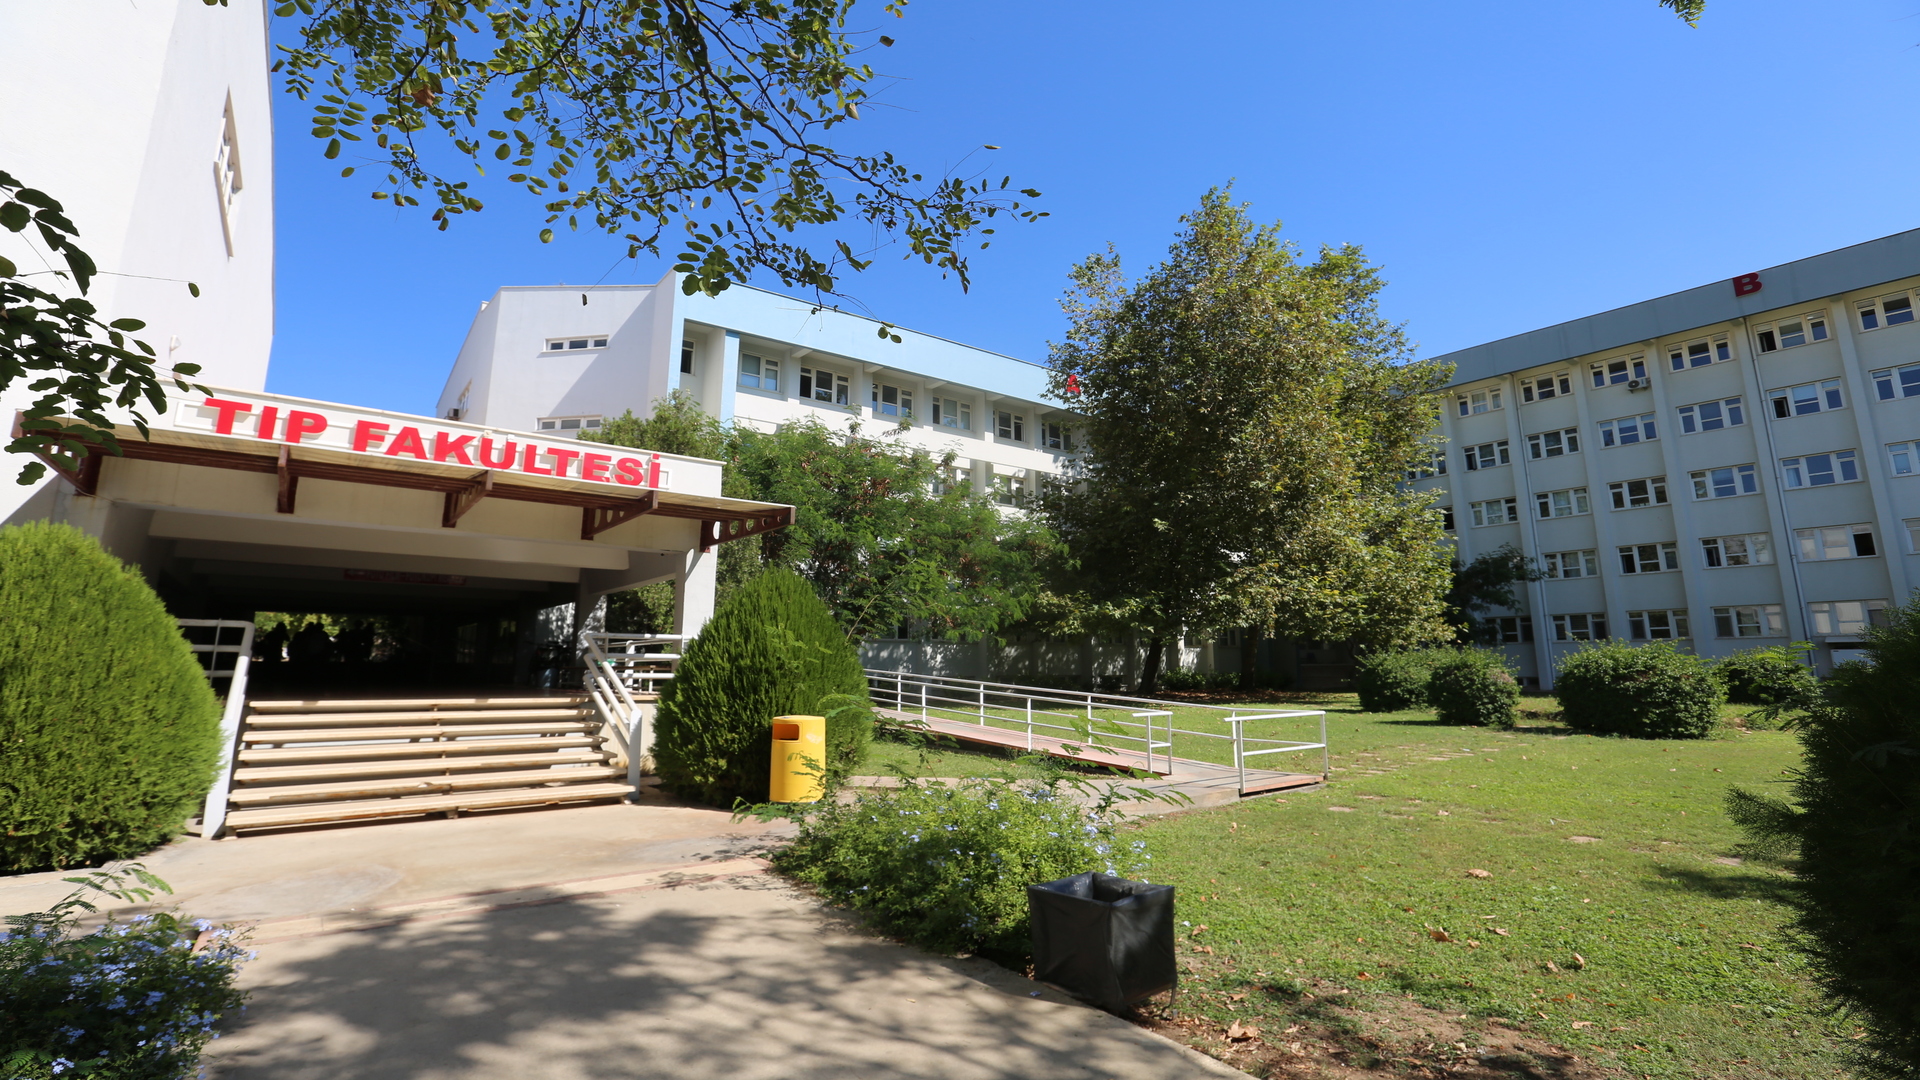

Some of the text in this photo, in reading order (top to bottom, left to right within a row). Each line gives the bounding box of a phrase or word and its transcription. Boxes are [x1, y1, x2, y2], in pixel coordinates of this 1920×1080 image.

[1732, 272, 1763, 297] B
[1066, 374, 1081, 394] A
[204, 397, 661, 489] TIP FAKÜLTESİ
